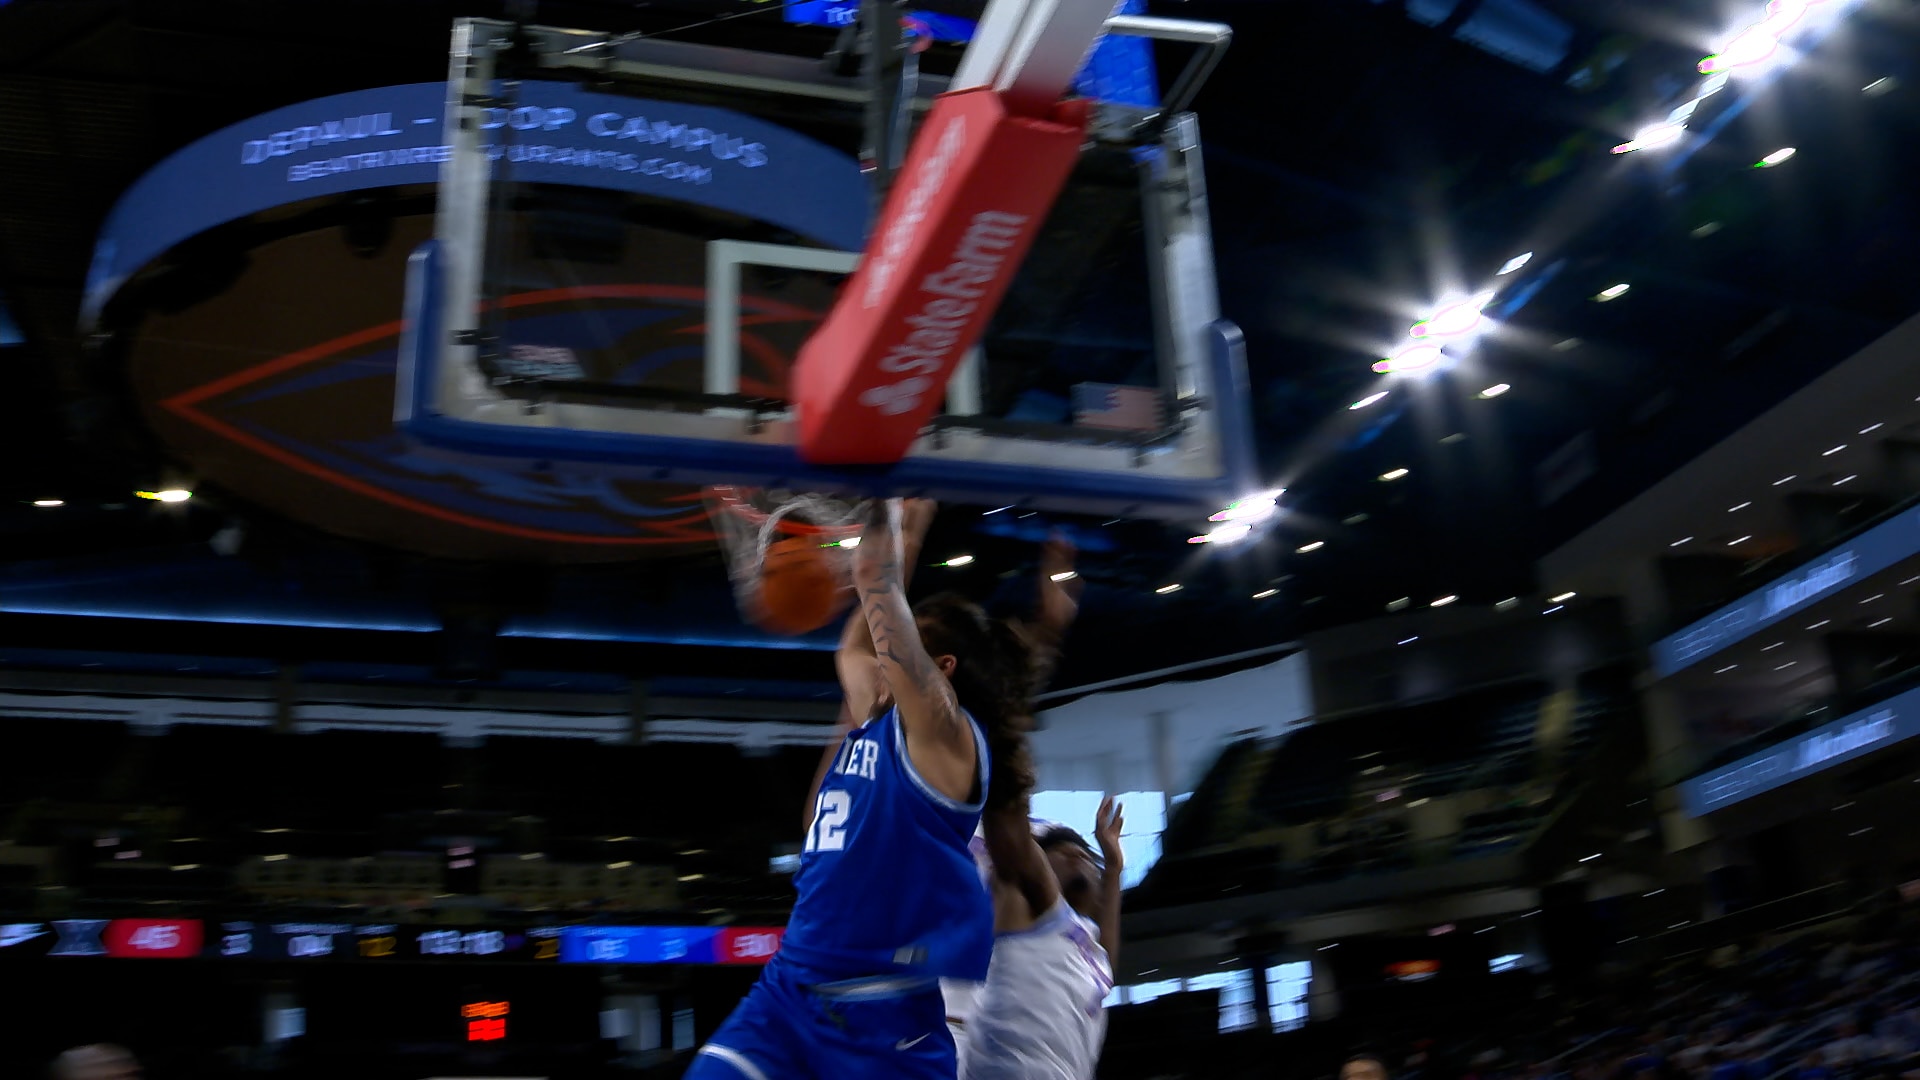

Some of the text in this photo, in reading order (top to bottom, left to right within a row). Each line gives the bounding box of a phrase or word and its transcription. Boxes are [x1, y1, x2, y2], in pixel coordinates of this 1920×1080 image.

[240, 112, 403, 165] DEPAUL
[479, 106, 577, 132] OOP
[586, 111, 769, 168] CAMPUS
[834, 738, 880, 781] IER
[805, 789, 852, 853] 12
